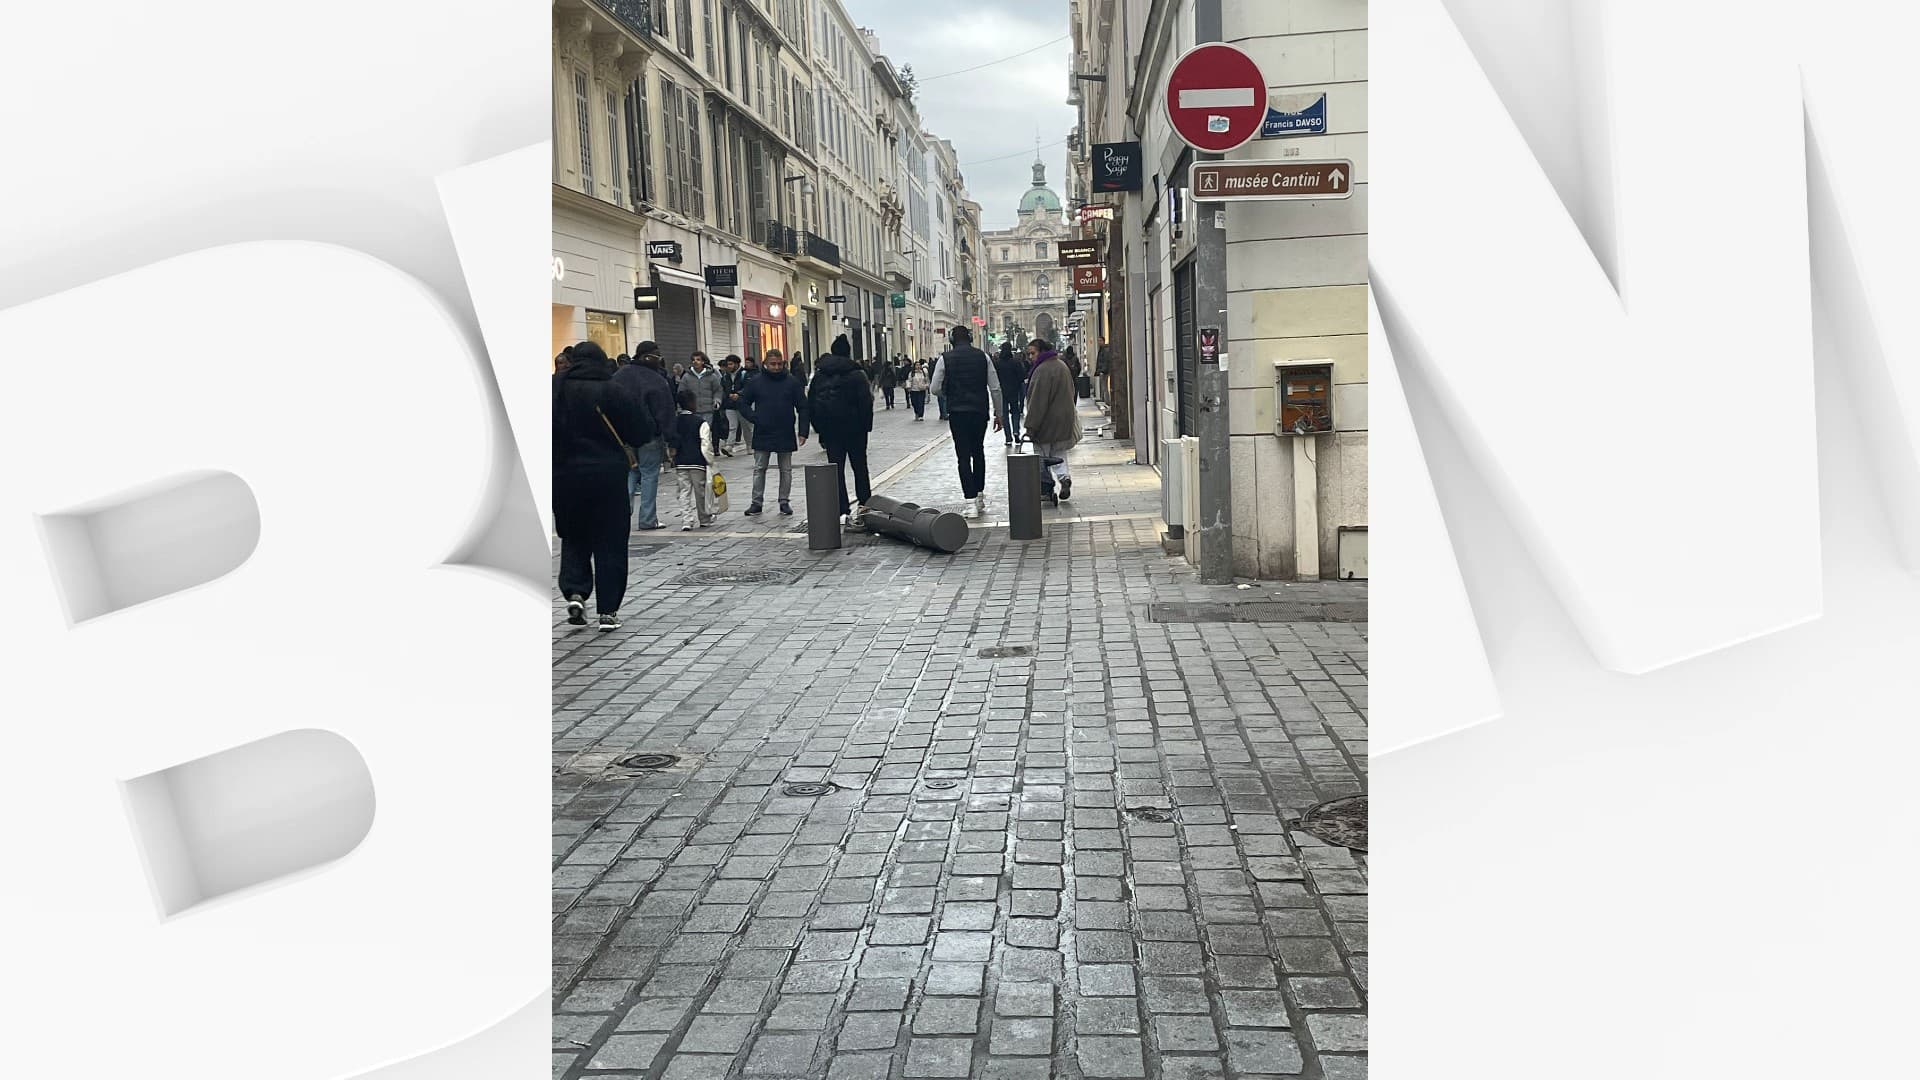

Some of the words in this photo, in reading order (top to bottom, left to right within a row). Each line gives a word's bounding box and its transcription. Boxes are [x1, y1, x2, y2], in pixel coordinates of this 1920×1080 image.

[1265, 120, 1294, 129] Francis
[1295, 117, 1322, 127] DAVSO
[1104, 147, 1129, 166] Peggy
[1224, 172, 1268, 189] musée
[1271, 172, 1321, 188] Cantini
[1081, 208, 1114, 221] CAMPER
[651, 244, 674, 254] VANS
[1080, 275, 1097, 285] avril
